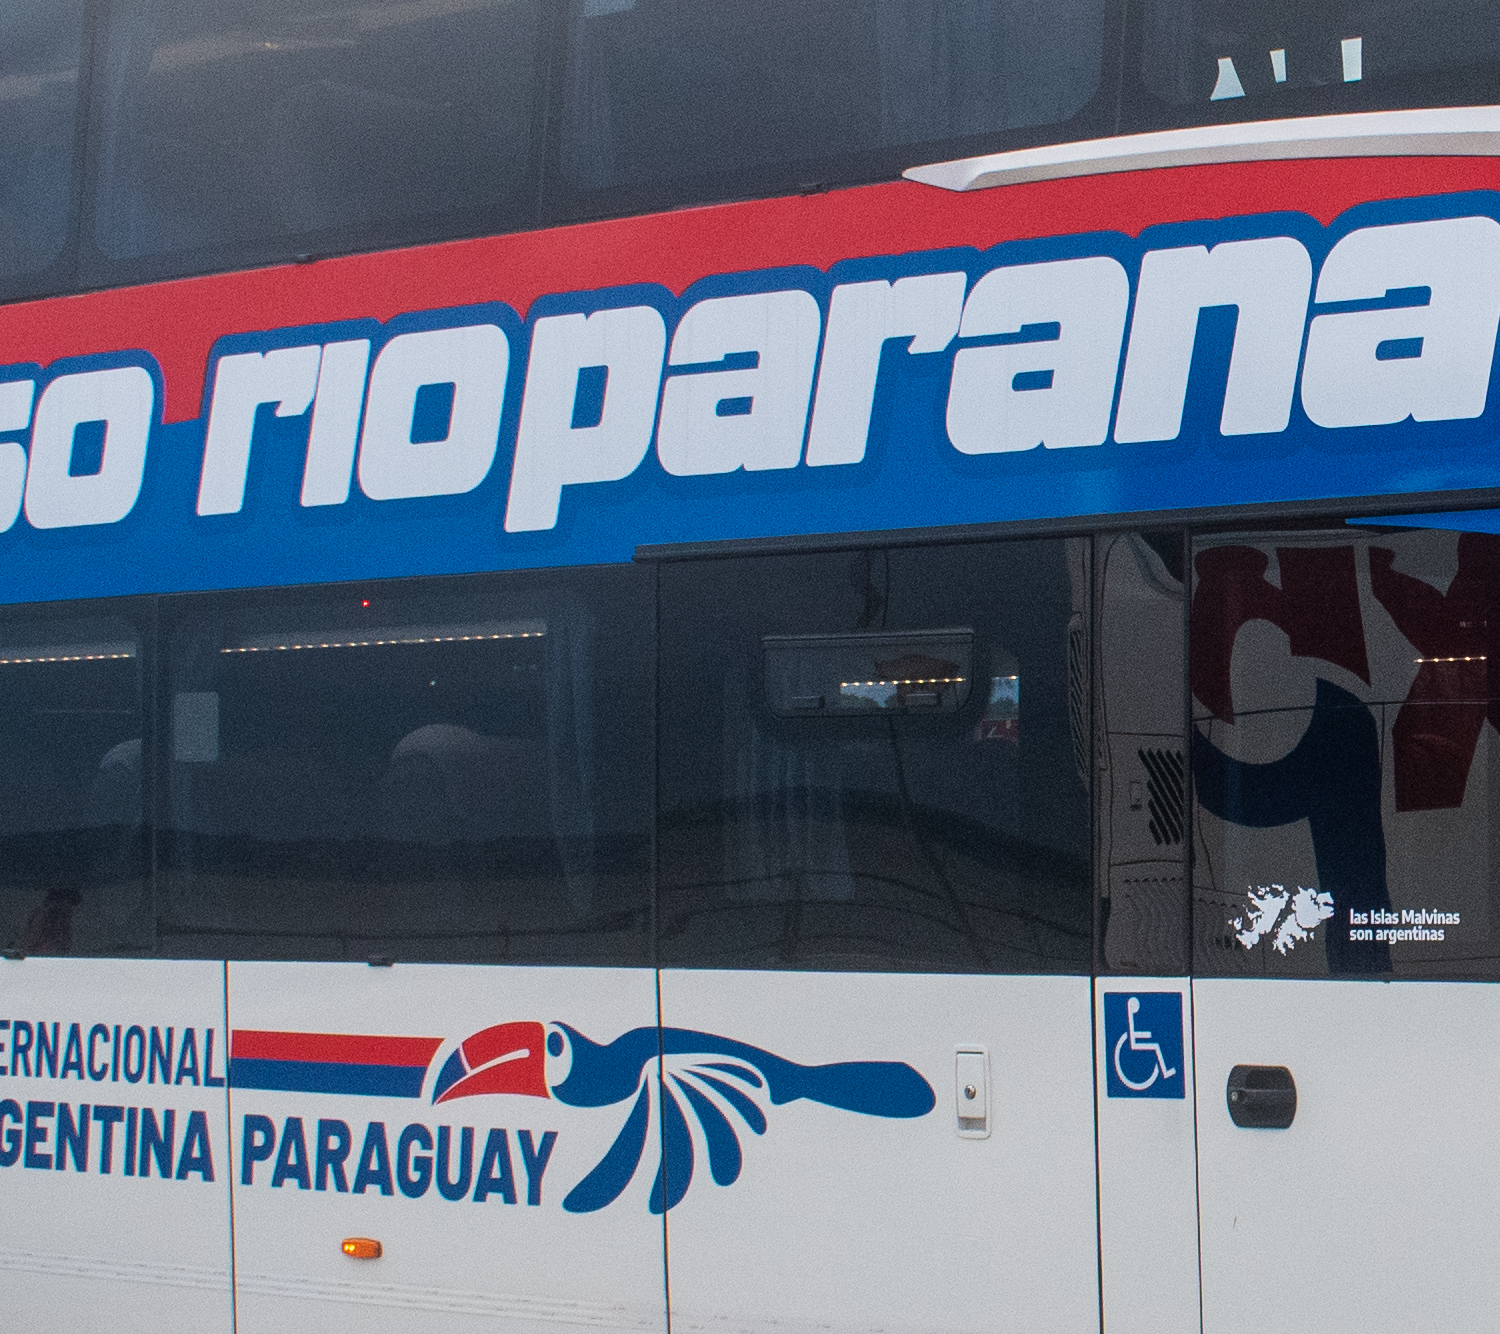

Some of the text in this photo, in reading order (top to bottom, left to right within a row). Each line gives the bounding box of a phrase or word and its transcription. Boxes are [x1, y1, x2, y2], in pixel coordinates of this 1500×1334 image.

[1350, 908, 1460, 925] las Islas Malvinas
[1350, 926, 1445, 944] son argentinas
[240, 1113, 559, 1207] PARAGUAY
